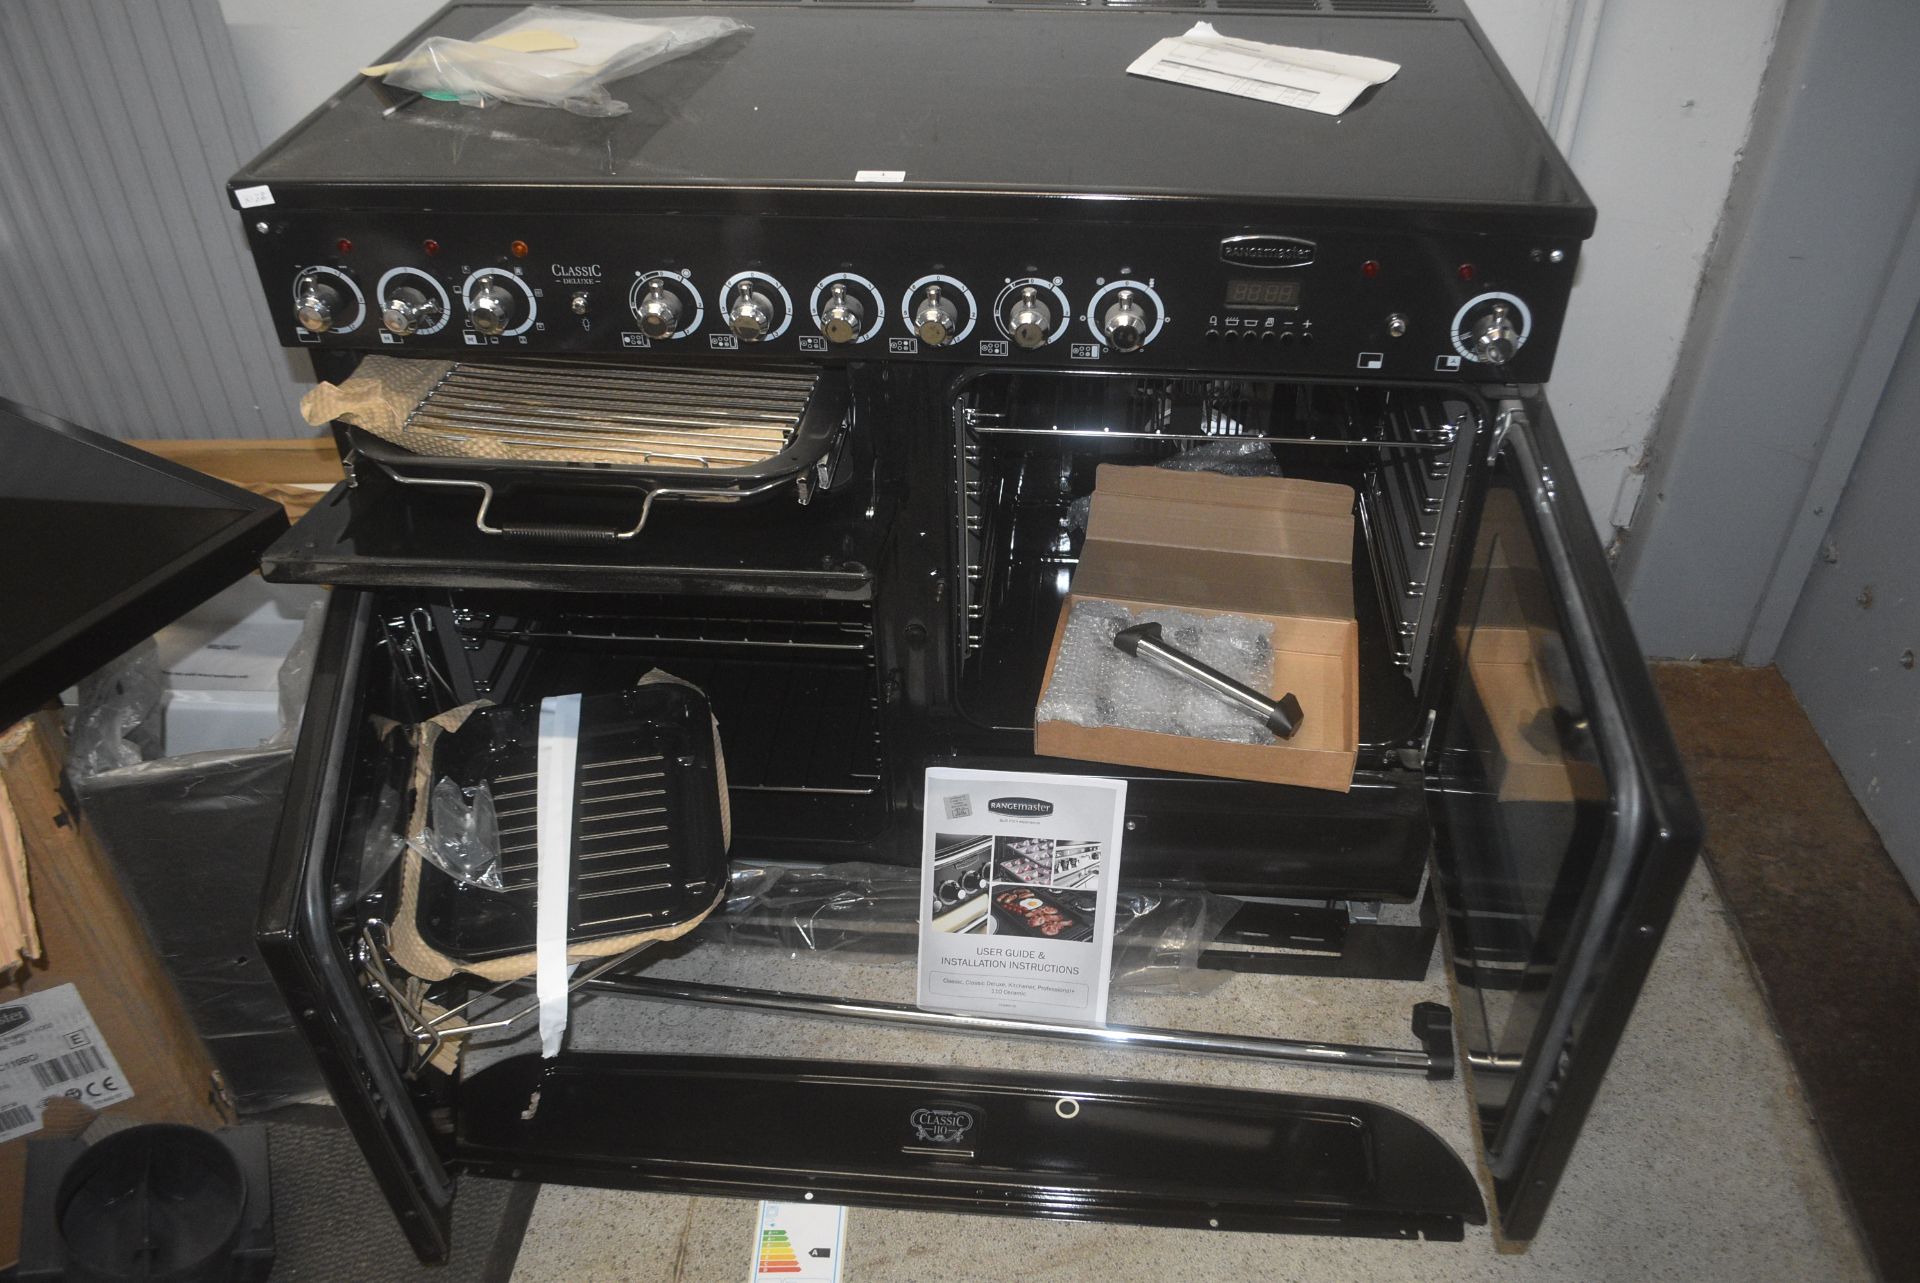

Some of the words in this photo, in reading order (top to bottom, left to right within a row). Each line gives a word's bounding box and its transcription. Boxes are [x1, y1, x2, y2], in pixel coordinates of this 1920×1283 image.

[552, 263, 602, 277] CLASSIC
[990, 802, 1051, 812] RANGEmaster
[976, 947, 1003, 957] USER
[1005, 948, 1035, 959] GUIDE
[1038, 951, 1046, 960] &
[941, 957, 1007, 969] INSTALLATION
[1009, 960, 1080, 976] INSTRUCTIONS
[919, 1112, 965, 1127] CLASSIC
[933, 1125, 948, 1135] 110
